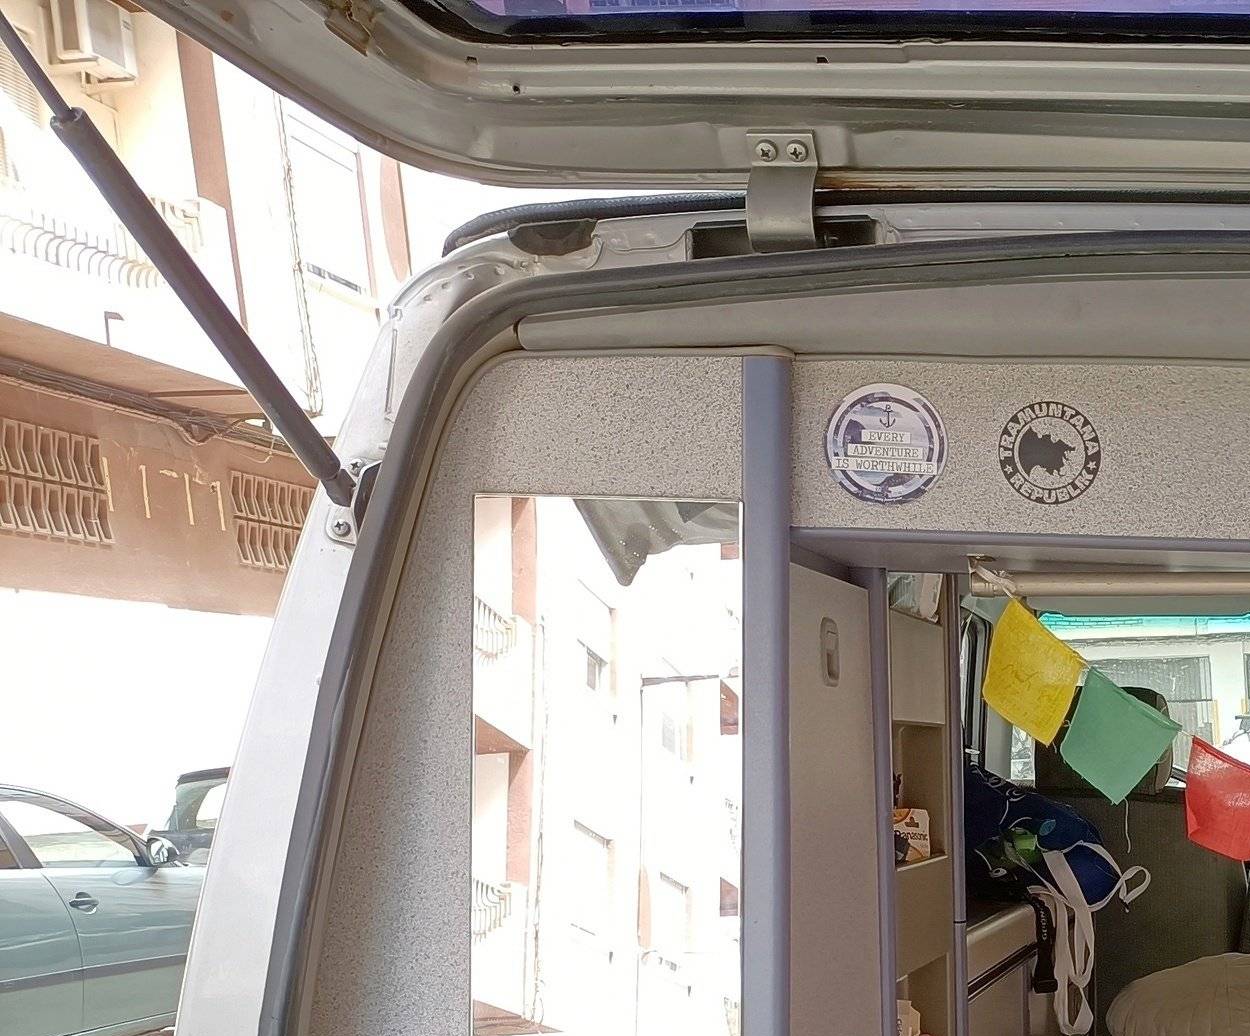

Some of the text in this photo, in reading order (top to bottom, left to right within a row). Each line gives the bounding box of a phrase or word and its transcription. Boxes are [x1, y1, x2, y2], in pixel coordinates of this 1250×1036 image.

[868, 431, 905, 443] EVERY
[999, 403, 1100, 461] TRAMUNTANA
[852, 445, 919, 458] ADVENTURE
[835, 458, 934, 474] IS WORTHWHILE
[1009, 469, 1094, 503] REPUBLIK
